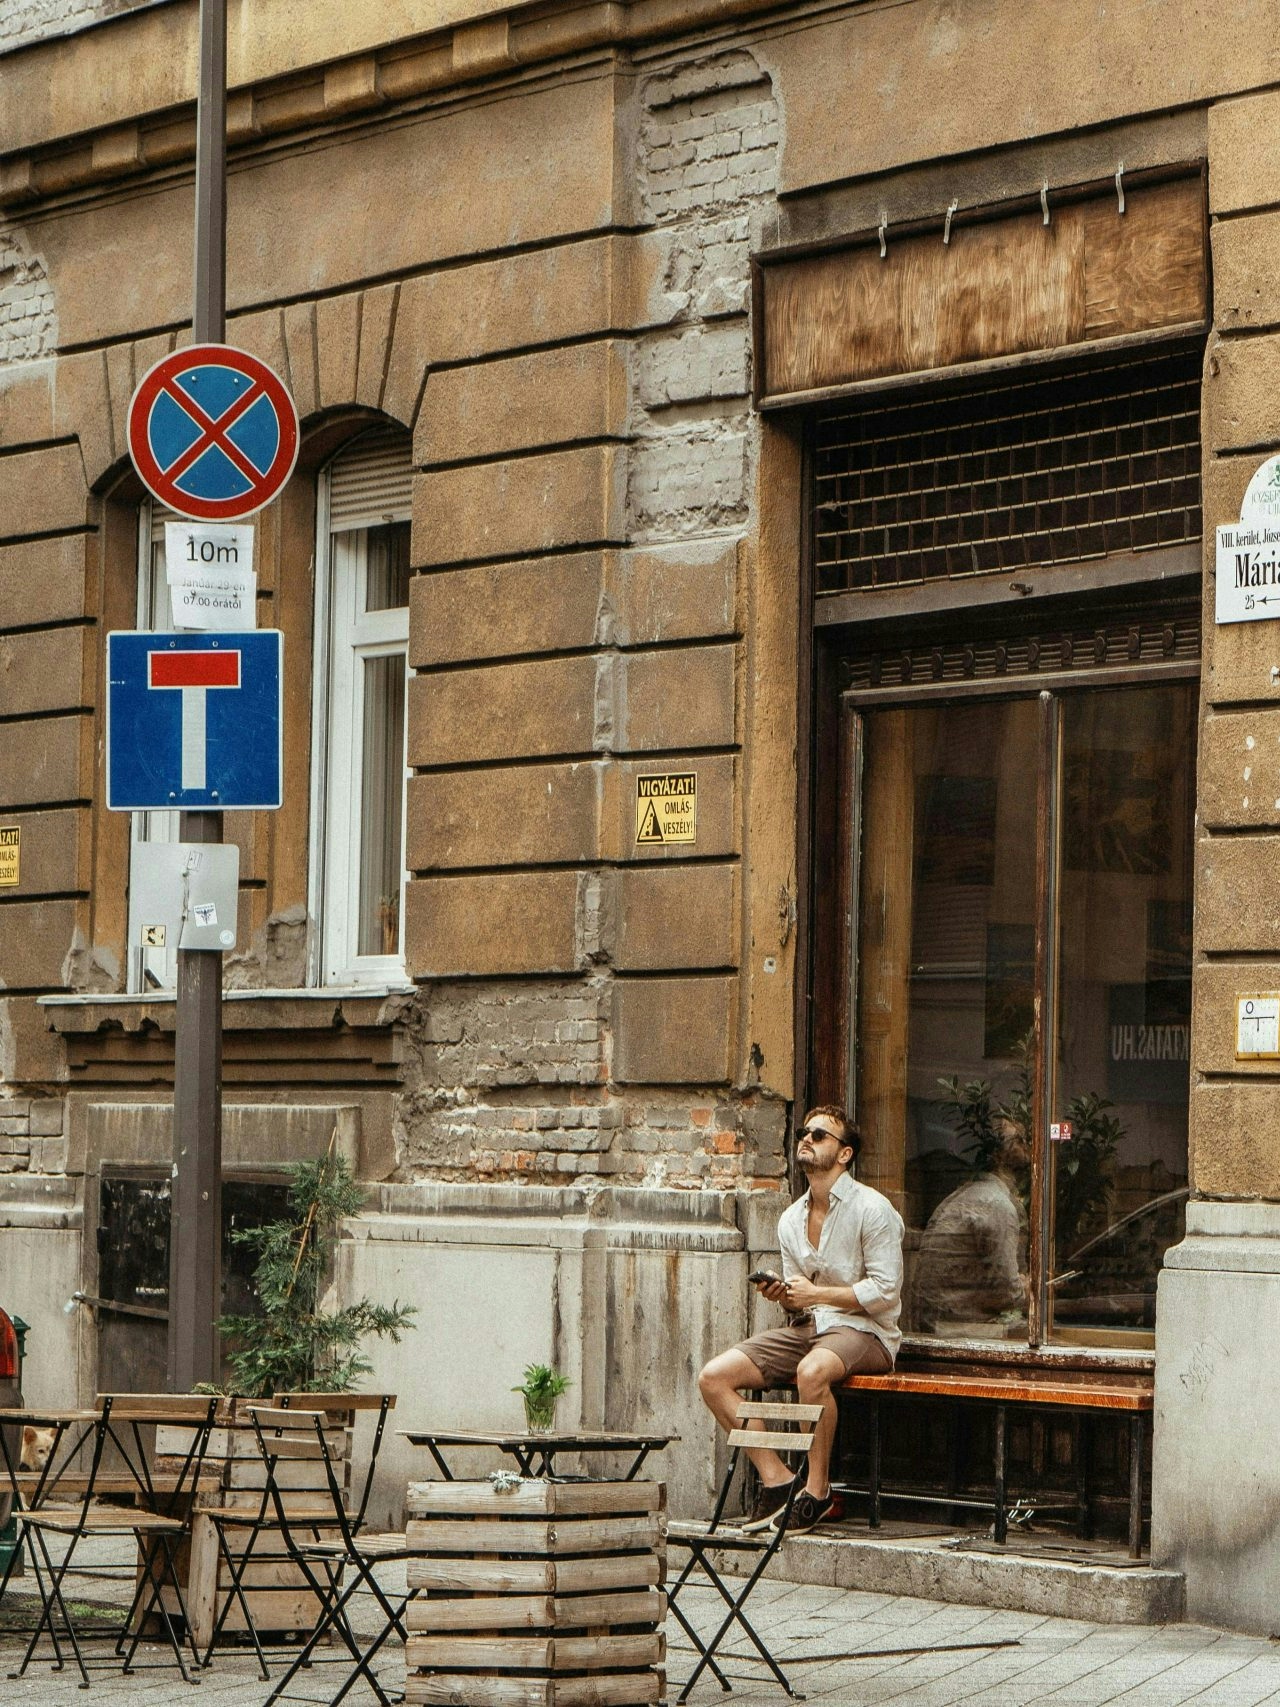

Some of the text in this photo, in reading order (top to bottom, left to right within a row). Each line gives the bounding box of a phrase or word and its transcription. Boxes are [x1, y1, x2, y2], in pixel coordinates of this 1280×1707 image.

[1221, 533, 1234, 549] VIII.
[1236, 529, 1261, 547] kerület,
[186, 541, 238, 563] 10m
[183, 596, 242, 609] 07.00 órától
[1245, 595, 1255, 610] 25
[640, 775, 694, 796] VIGYÁZAT!
[664, 798, 692, 814] OMLÁS-
[663, 818, 693, 834] VESZÉLY!
[0, 830, 18, 845] ZAT!
